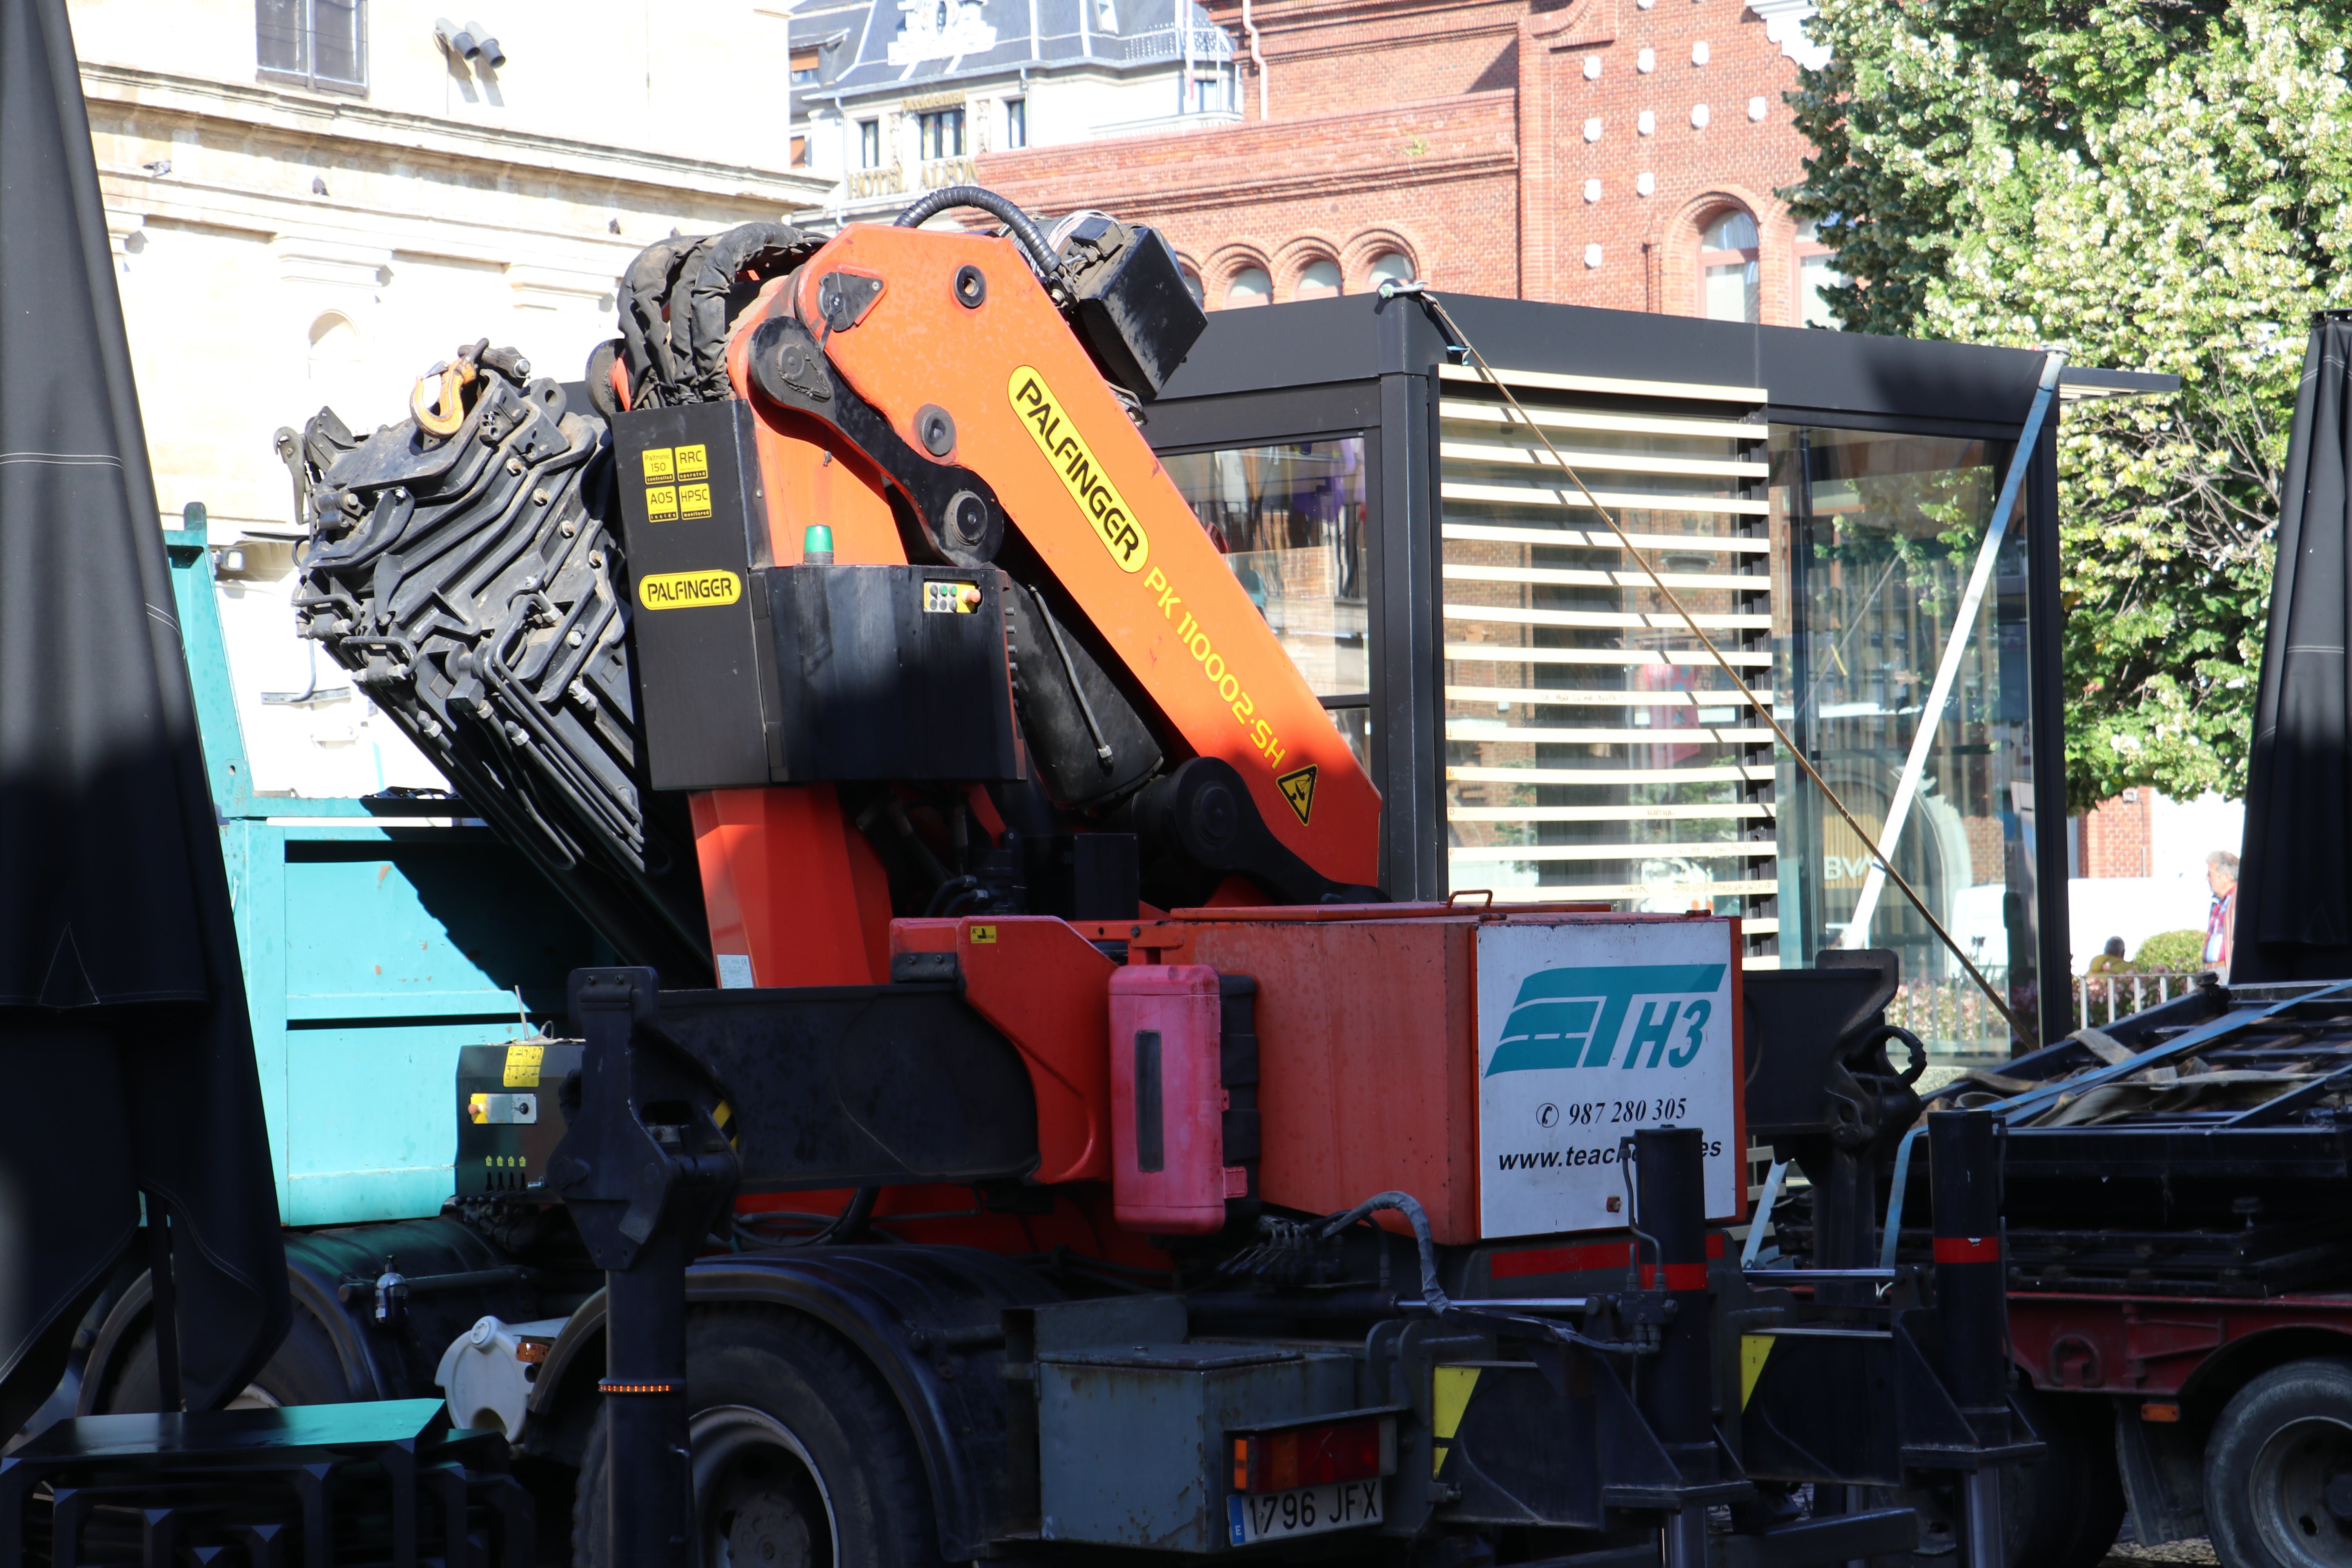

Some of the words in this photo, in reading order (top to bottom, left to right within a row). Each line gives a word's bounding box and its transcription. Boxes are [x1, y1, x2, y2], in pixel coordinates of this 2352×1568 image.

[848, 164, 909, 200] HOTEL
[651, 463, 666, 472] 150
[679, 451, 702, 464] RRC
[1015, 377, 1140, 562] PALFINGER
[650, 492, 673, 505] AOS
[681, 489, 708, 502] HPSC
[647, 578, 733, 602] PALFINGER
[1144, 566, 1182, 620] PK
[1569, 1102, 1605, 1125] 987
[1611, 1100, 1647, 1123] 280
[1652, 1097, 1687, 1120] 305
[1249, 1491, 1316, 1535] 1796
[1328, 1481, 1377, 1523] JFX
[1235, 1525, 1241, 1535] E
